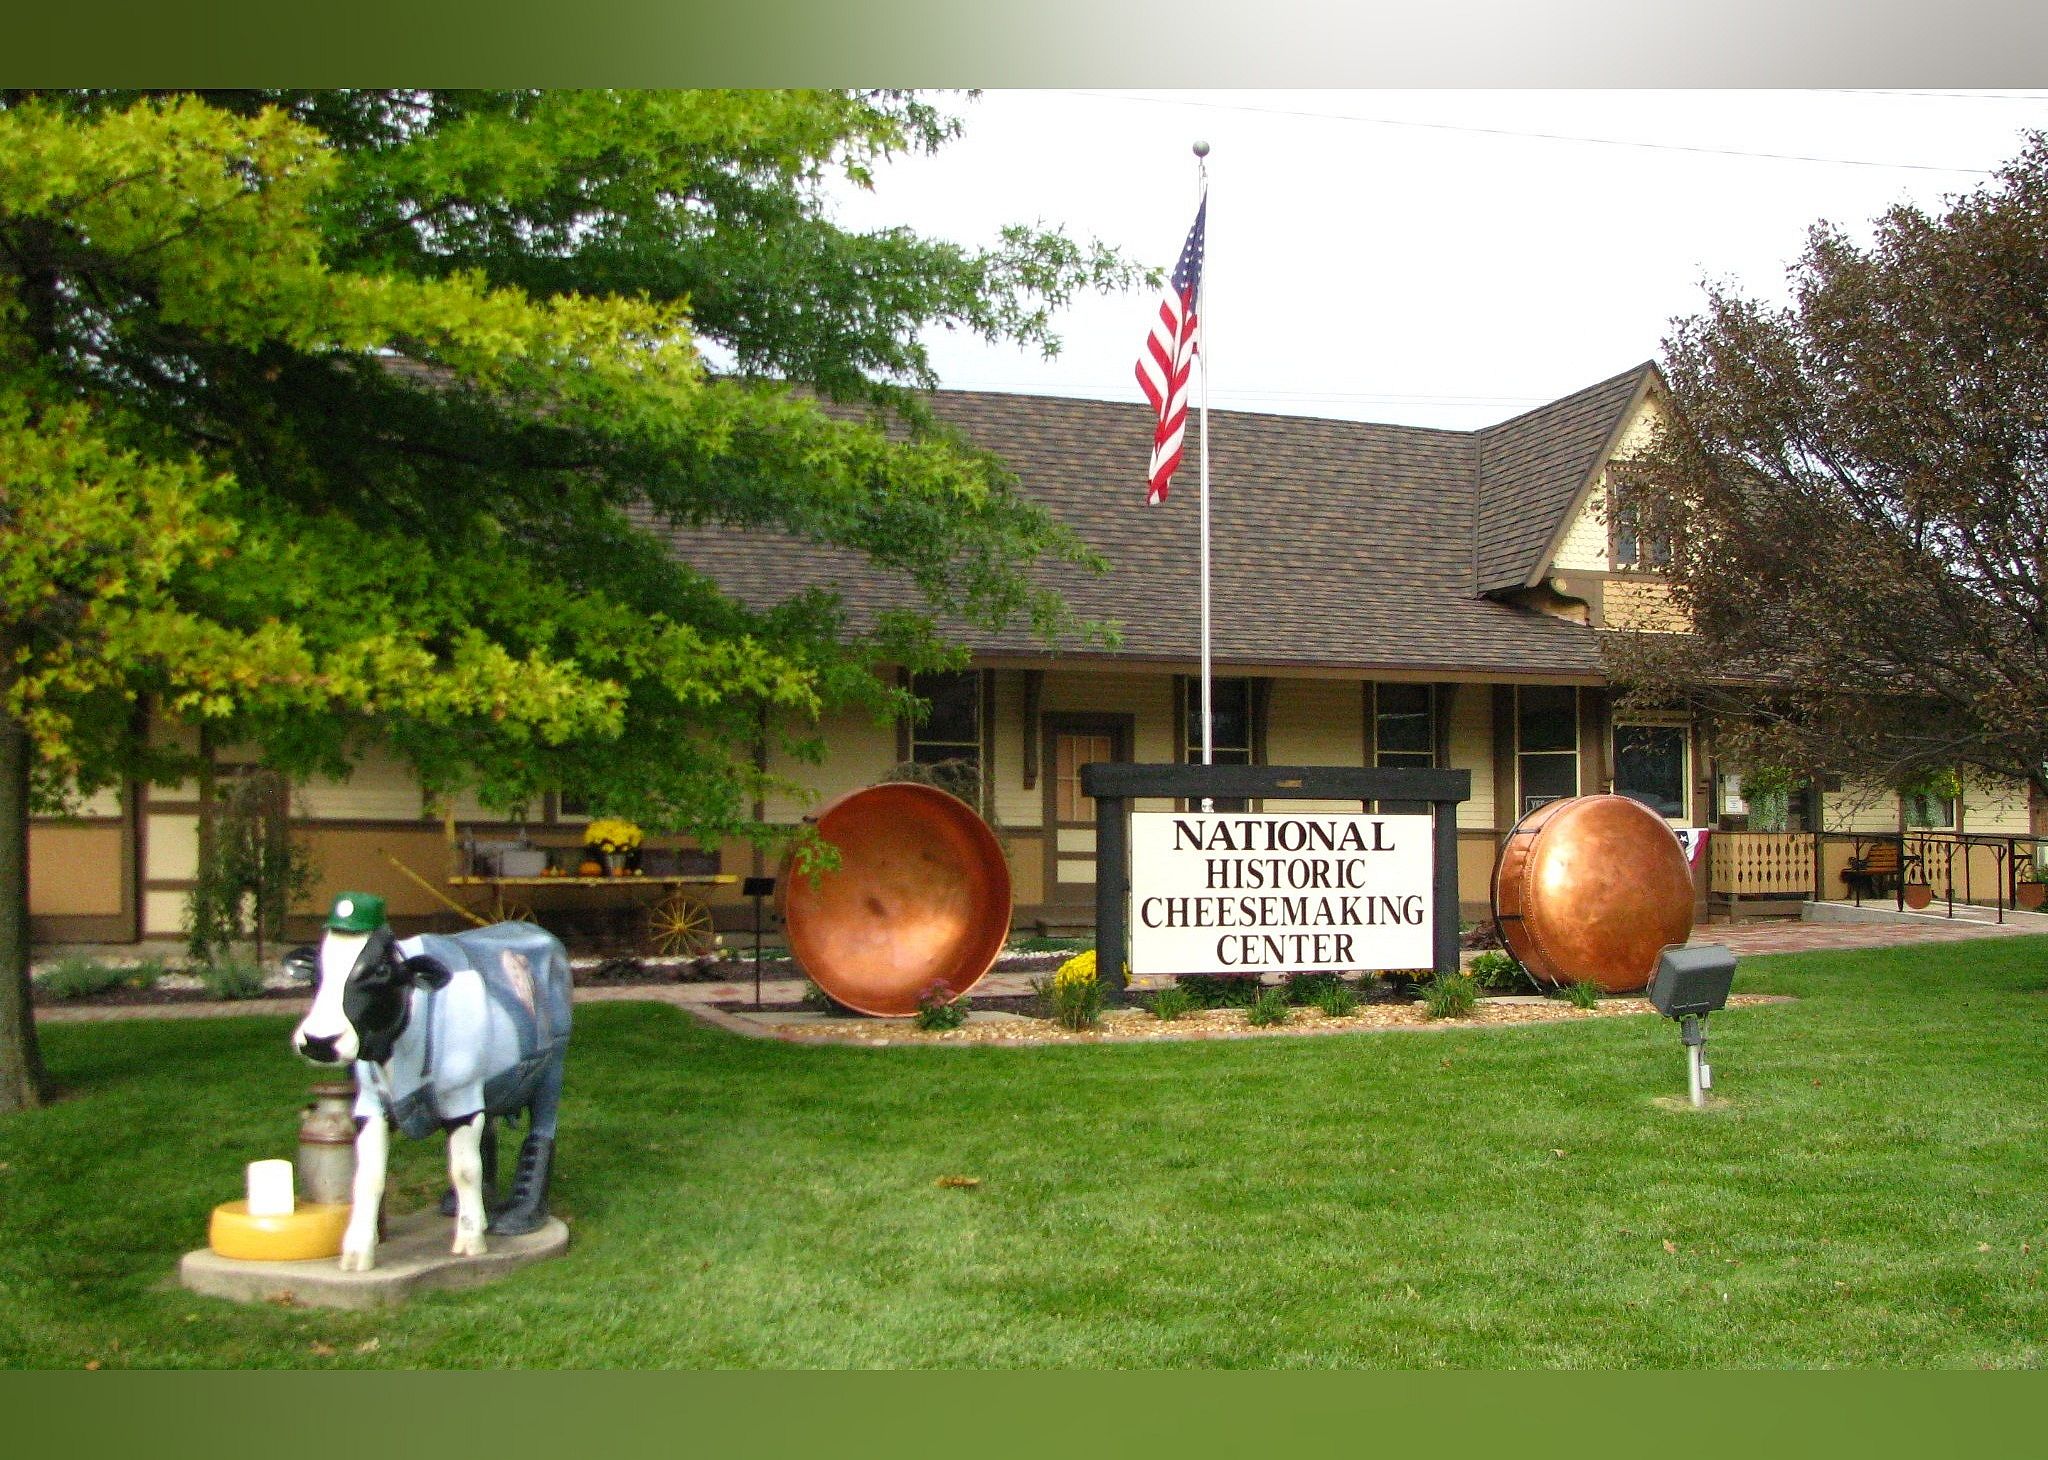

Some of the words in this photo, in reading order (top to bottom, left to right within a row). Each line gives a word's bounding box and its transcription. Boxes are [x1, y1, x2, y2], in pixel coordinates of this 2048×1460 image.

[1173, 820, 1396, 852] NATIONAL
[1205, 858, 1366, 890] HISTORIC
[1141, 894, 1425, 929] CHEESEMAKING
[1216, 933, 1355, 966] CENTER
